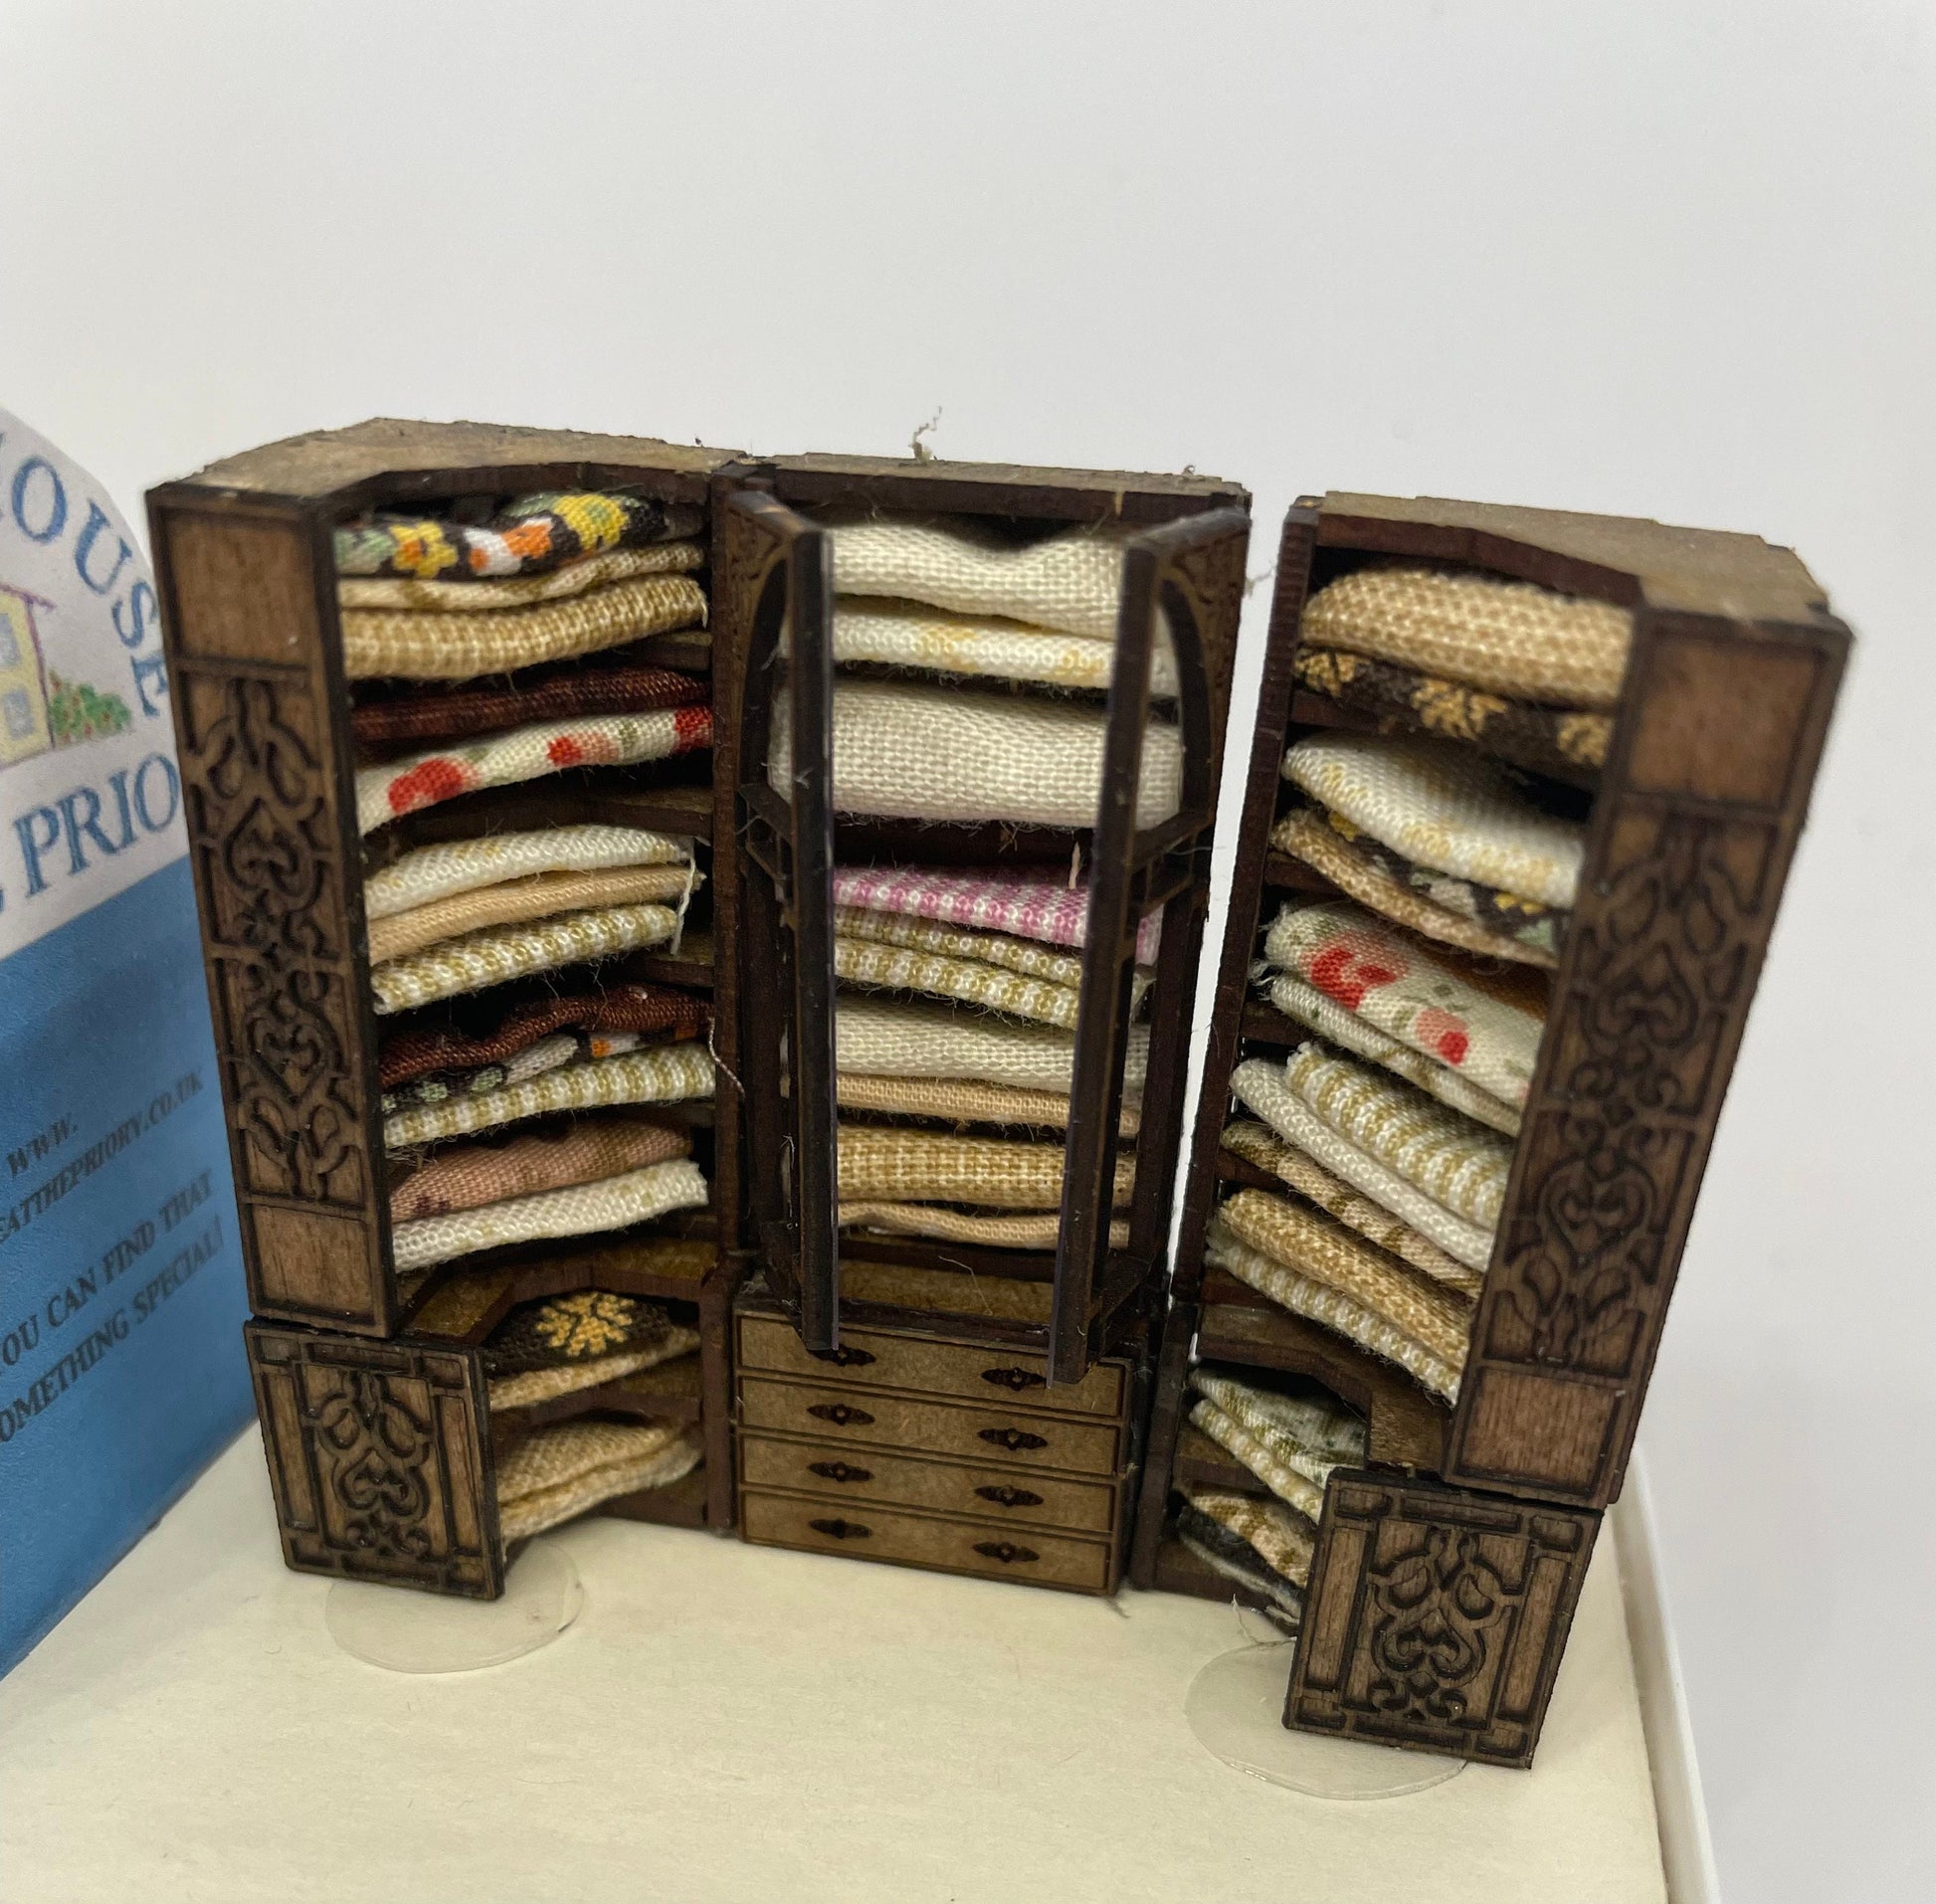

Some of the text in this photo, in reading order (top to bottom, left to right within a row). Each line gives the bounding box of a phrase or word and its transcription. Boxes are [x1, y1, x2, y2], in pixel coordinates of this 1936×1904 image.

[0, 432, 167, 718] OUSE
[13, 753, 179, 897] PRIO
[0, 1168, 212, 1373] OU CAN FIND THAT
[133, 1213, 224, 1325] SPECIAL!
